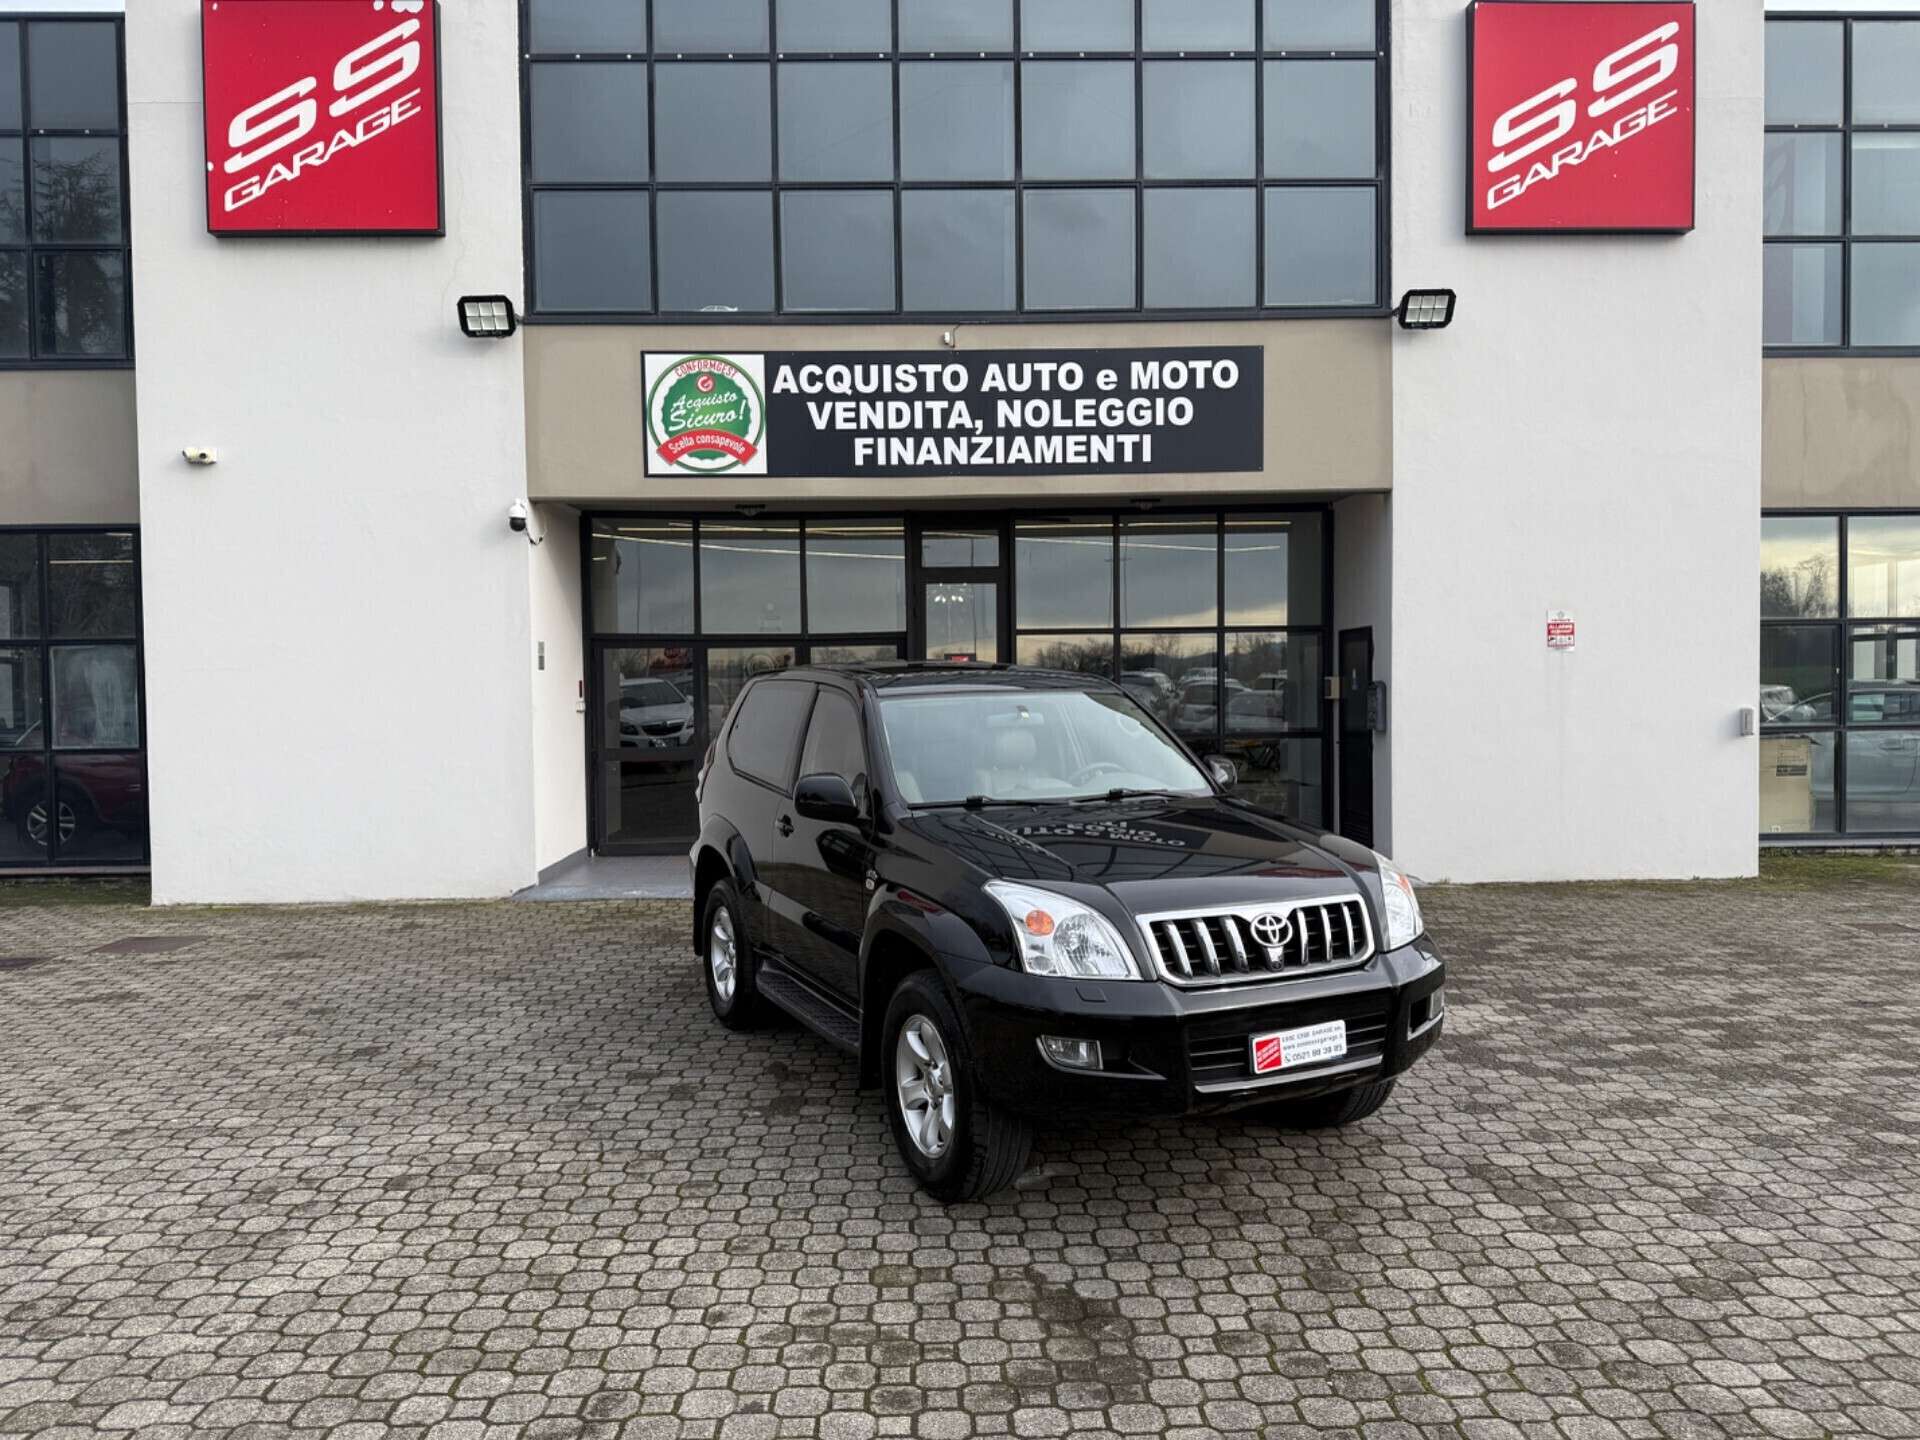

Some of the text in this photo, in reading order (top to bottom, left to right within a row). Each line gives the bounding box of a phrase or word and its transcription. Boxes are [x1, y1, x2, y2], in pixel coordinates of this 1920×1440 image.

[224, 18, 421, 174] SS
[1487, 21, 1679, 173] SS
[224, 88, 421, 212] GARAGE
[1487, 89, 1678, 210] GARAGE
[772, 360, 1239, 396] ACQUISTO AUTO e MOTO
[669, 399, 746, 431] Sicuro!
[671, 391, 738, 412] Acquisto
[806, 397, 1194, 434] VENDITA, NOLEGGIO
[667, 434, 746, 455] Scelta consapevole
[853, 433, 1152, 466] FINANZIAMENTI
